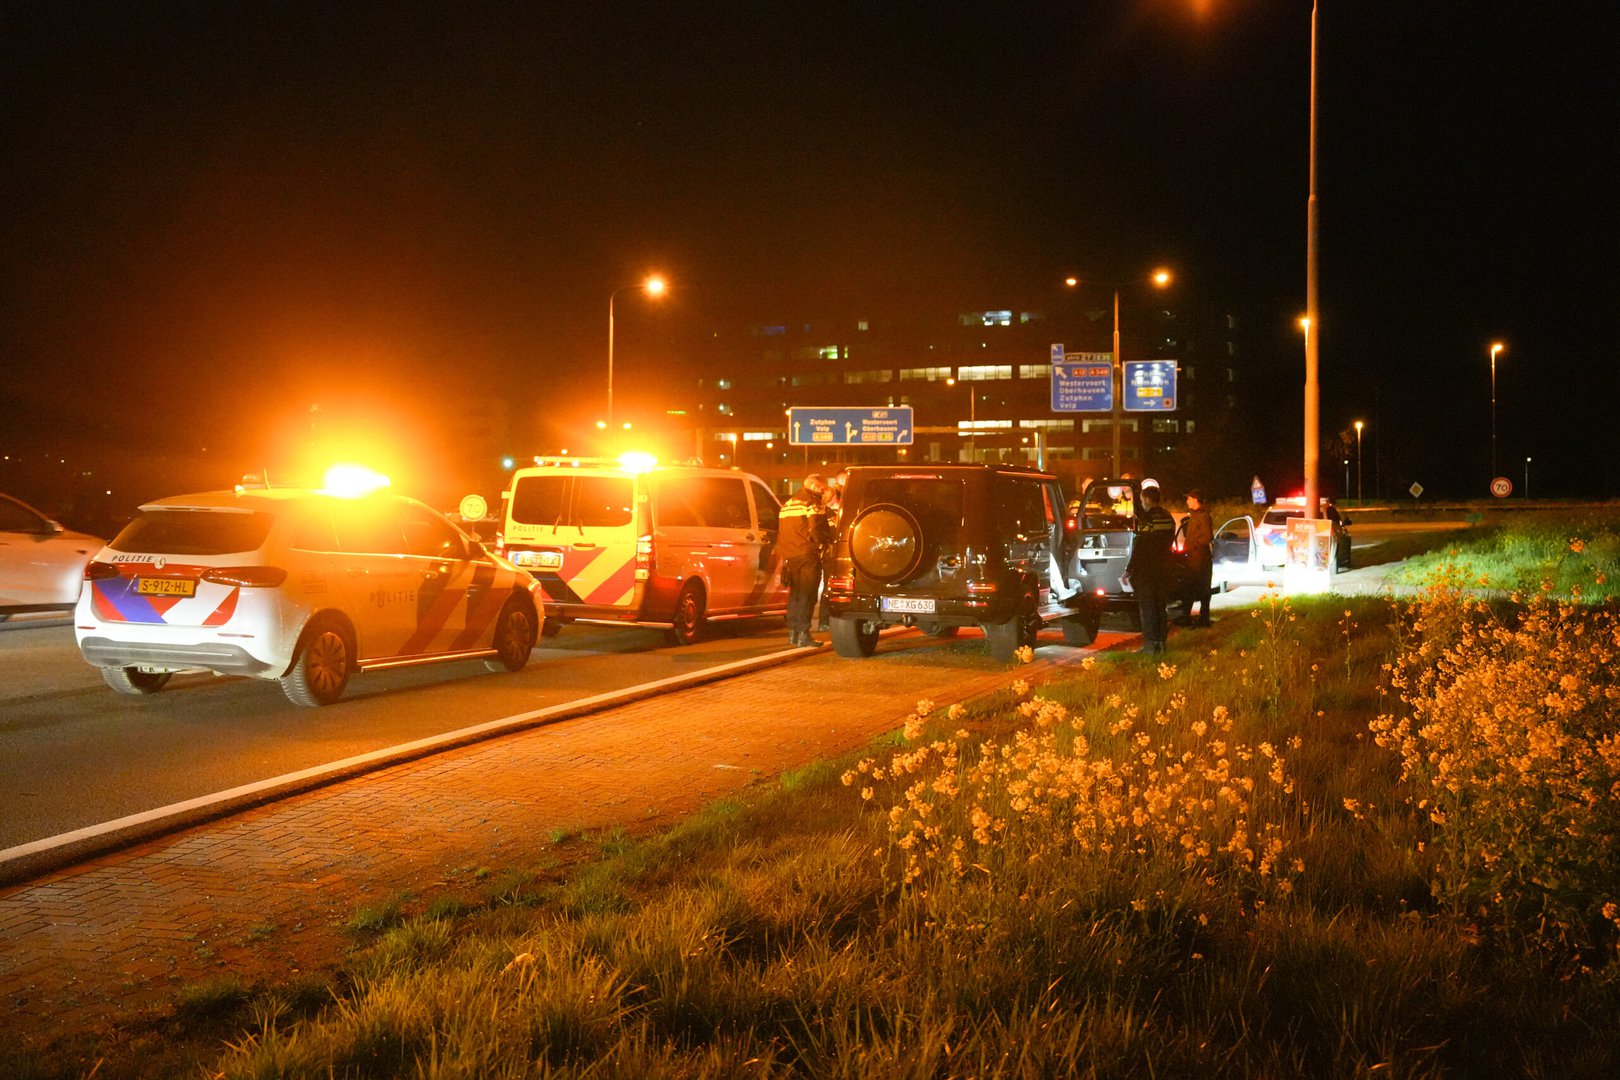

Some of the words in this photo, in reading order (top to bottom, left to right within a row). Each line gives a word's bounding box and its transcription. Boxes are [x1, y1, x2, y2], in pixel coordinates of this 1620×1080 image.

[1495, 483, 1508, 492] 70
[111, 555, 153, 563] POLITIE
[141, 580, 188, 593] S-912-HL
